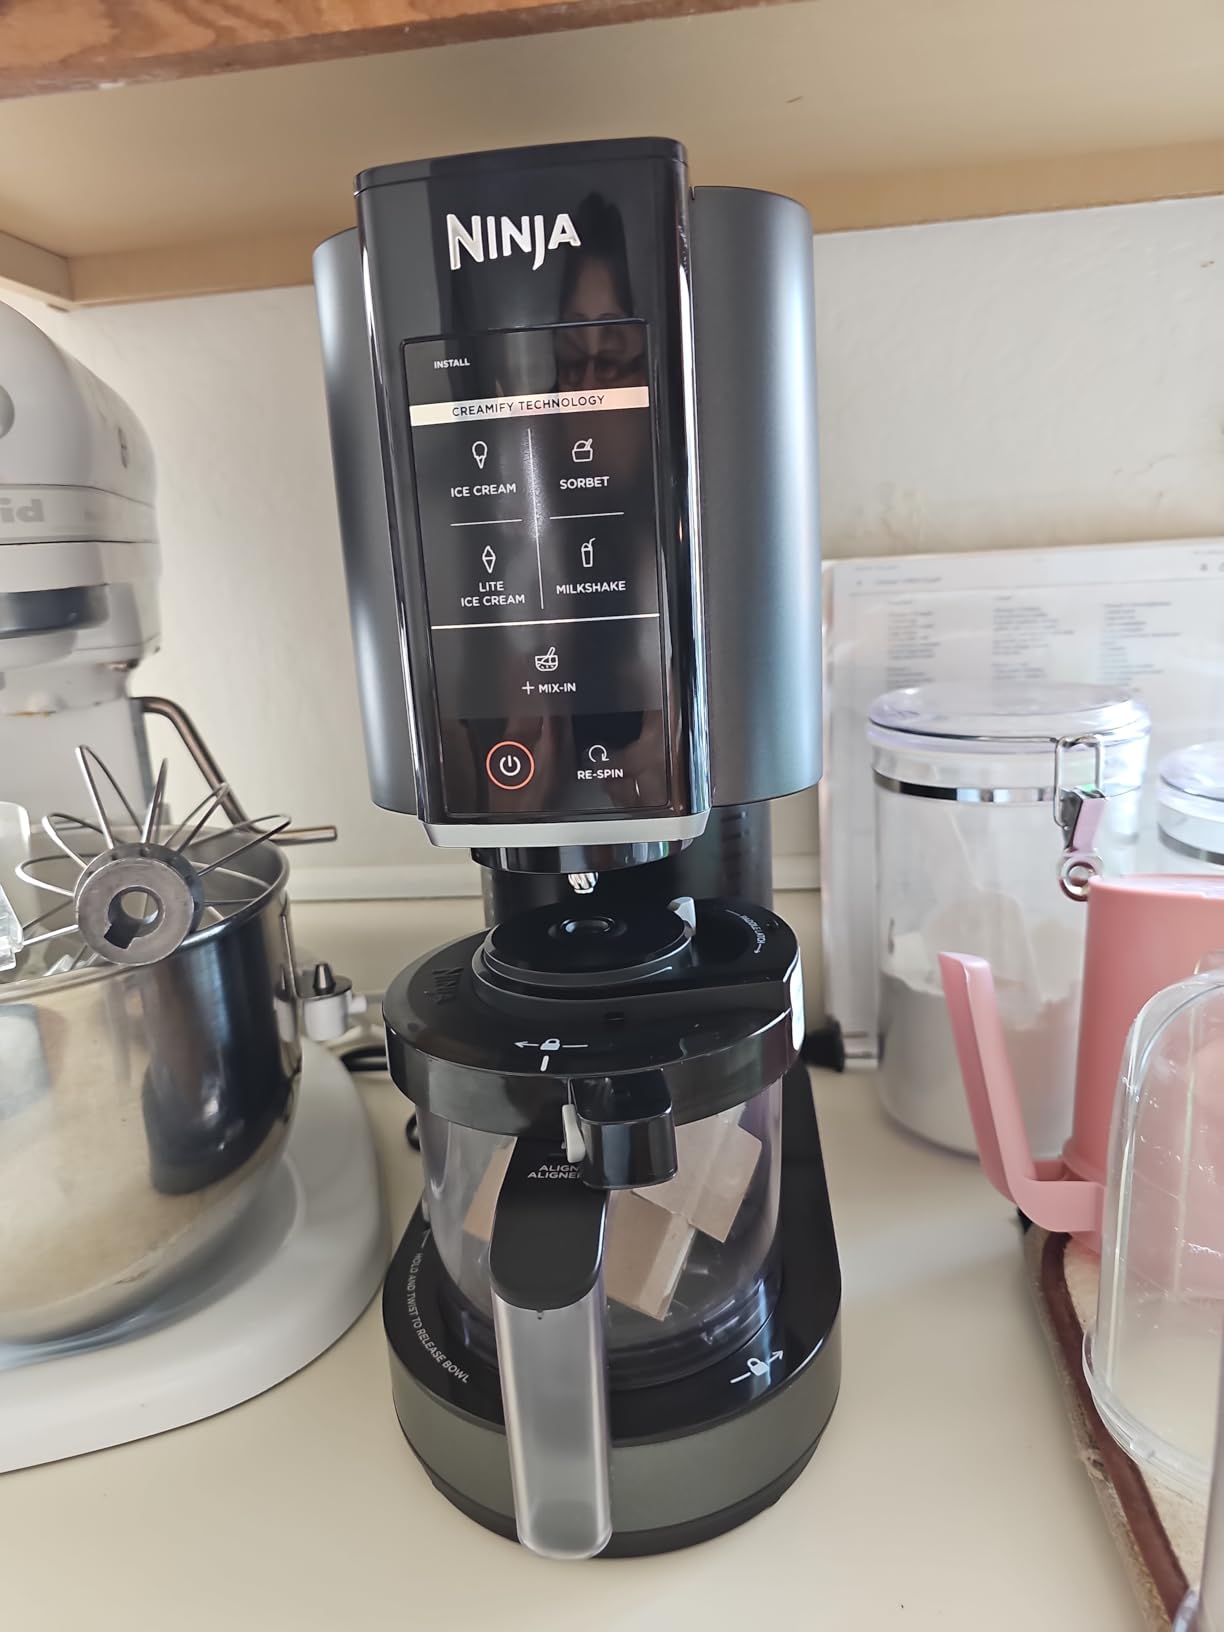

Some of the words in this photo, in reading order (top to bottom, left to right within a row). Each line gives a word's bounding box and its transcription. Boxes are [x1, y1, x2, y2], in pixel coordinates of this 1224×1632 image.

[446, 213, 582, 271] NINJA
[433, 357, 471, 369] INSTALL
[451, 401, 515, 418] CREAMIFY
[519, 394, 606, 411] TECHNOLOGY
[450, 486, 470, 498] ICE
[473, 483, 517, 496] CREAM
[559, 476, 610, 490] SORBET
[478, 580, 505, 593] LITE
[556, 580, 627, 595] MILKSHAKE
[460, 596, 481, 608] ICE
[483, 594, 526, 607] CREAM
[538, 682, 577, 694] MIX-IN
[577, 768, 624, 781] RE-SPIN
[410, 1252, 423, 1273] HOLD
[406, 1274, 417, 1291] AND
[406, 1292, 419, 1316] TWIST
[412, 1316, 423, 1329] TO
[416, 1328, 447, 1363] RELEASE
[442, 1359, 470, 1384] BOWL
